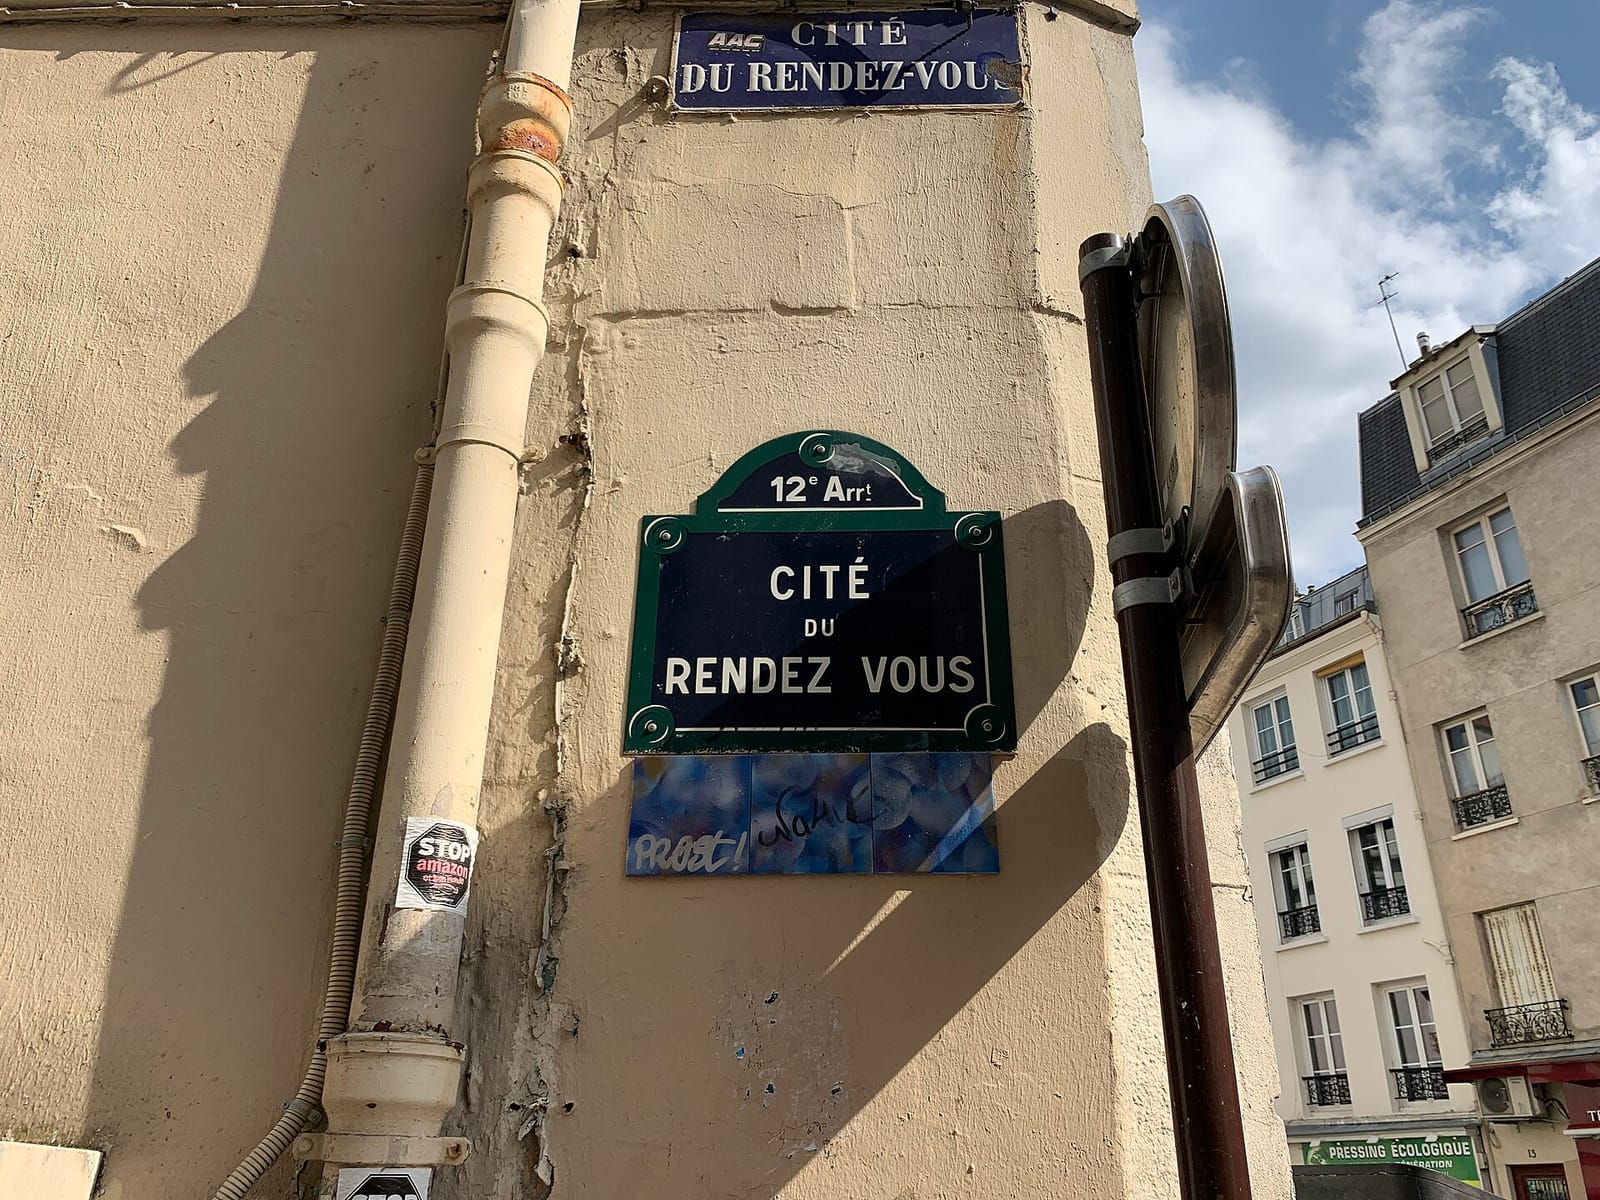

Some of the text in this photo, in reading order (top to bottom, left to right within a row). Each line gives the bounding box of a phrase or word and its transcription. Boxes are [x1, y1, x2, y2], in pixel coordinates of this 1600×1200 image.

[708, 32, 764, 47] AAC
[791, 16, 908, 47] CITÉ
[680, 63, 735, 94] DU
[769, 556, 870, 601] CITÉ
[804, 618, 835, 638] DU
[665, 655, 976, 695] RENDEZ VOUS
[418, 837, 471, 863] STOP
[416, 857, 469, 879] amazon
[1329, 1141, 1471, 1160] PRESSING ÉCOLOGIQUE
[1527, 1148, 1537, 1159] 13
